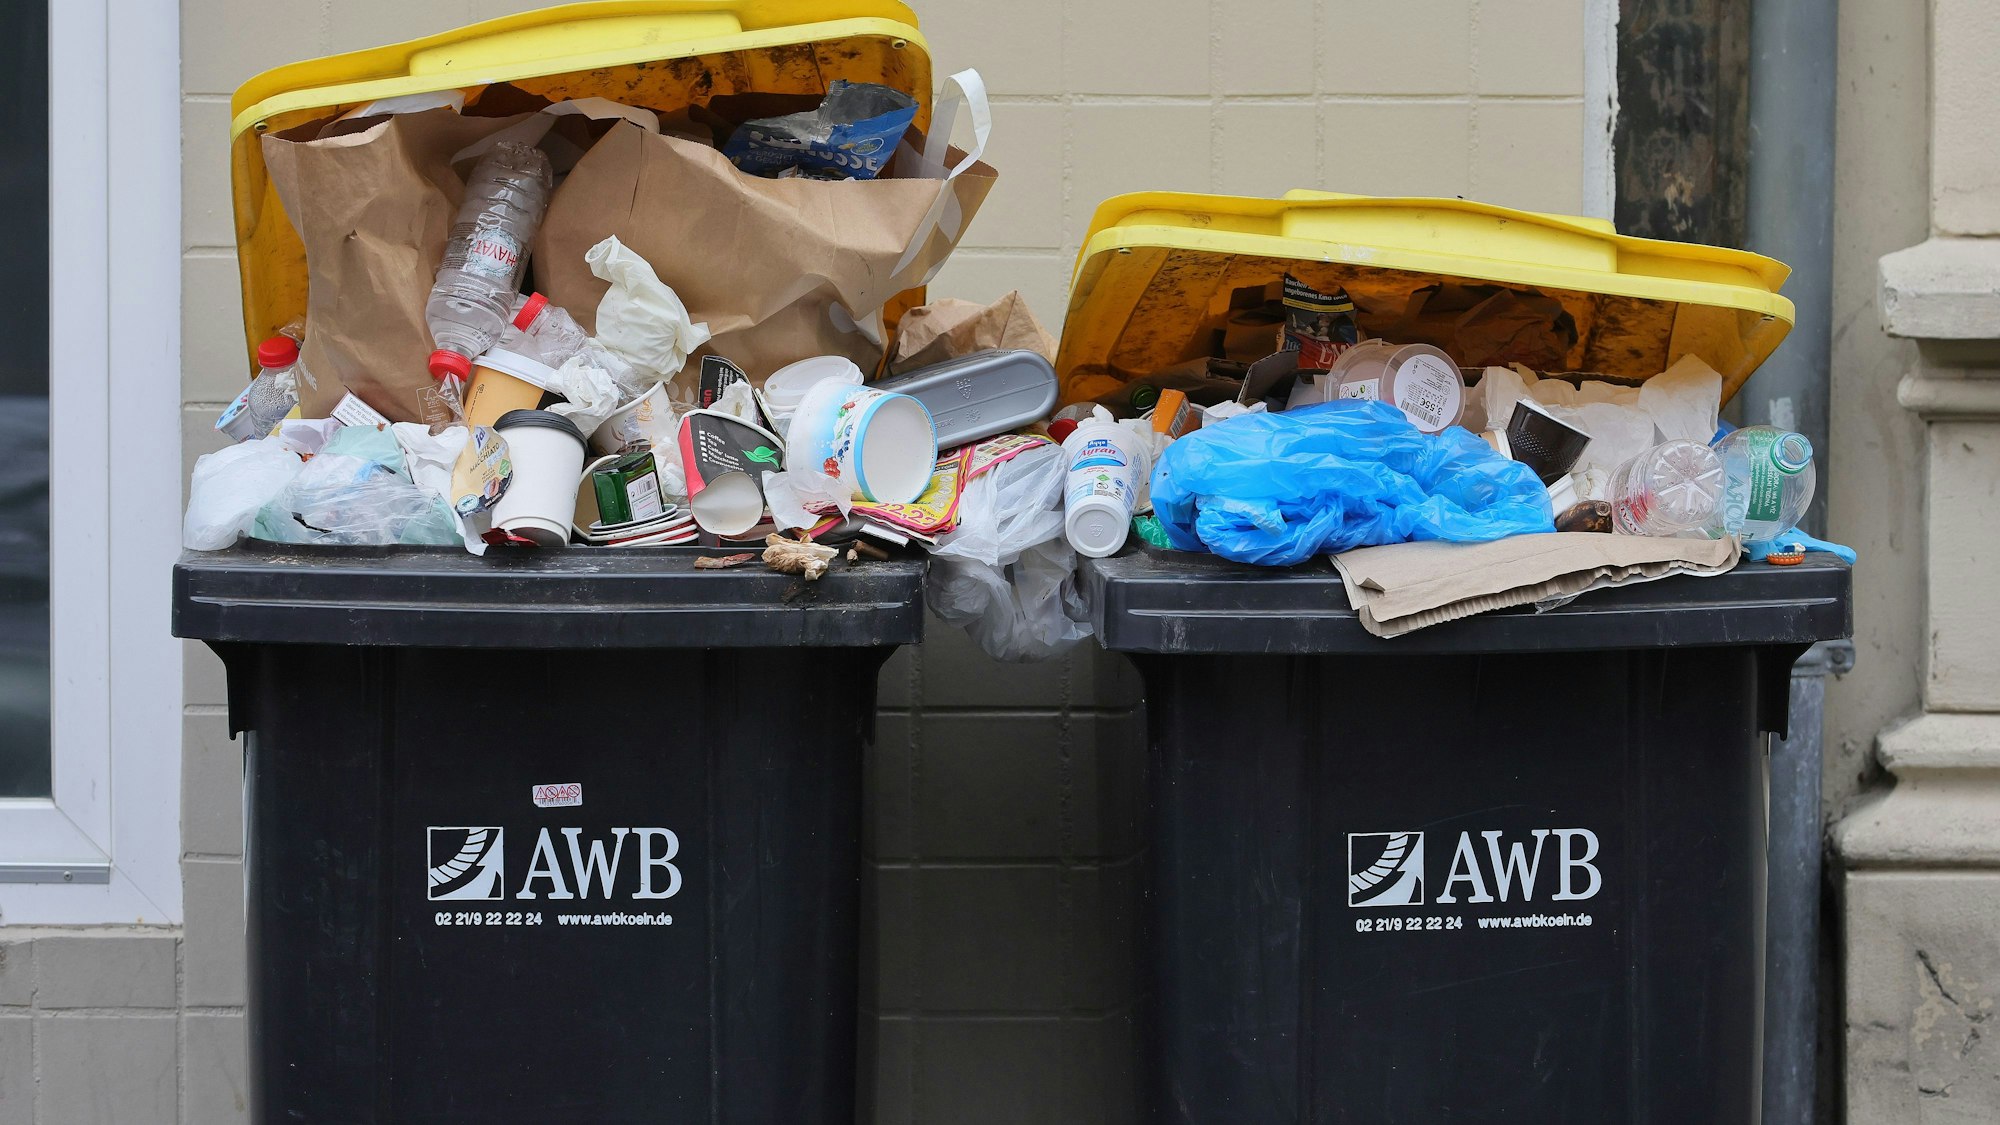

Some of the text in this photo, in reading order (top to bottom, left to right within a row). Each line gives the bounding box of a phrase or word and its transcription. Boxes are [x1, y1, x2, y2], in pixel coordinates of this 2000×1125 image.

[474, 240, 517, 268] HAYAT
[1420, 398, 1443, 416] 3,55€
[707, 432, 725, 445] Coffee
[1079, 447, 1116, 459] Ayran
[516, 827, 683, 900] AWB
[1436, 828, 1602, 904] AWB
[435, 911, 673, 926] 02 21/9 22 22 24 www.awbkoeln.de
[1356, 912, 1593, 933] 02 21/9 22 22 24 www.awbkoeln.de
